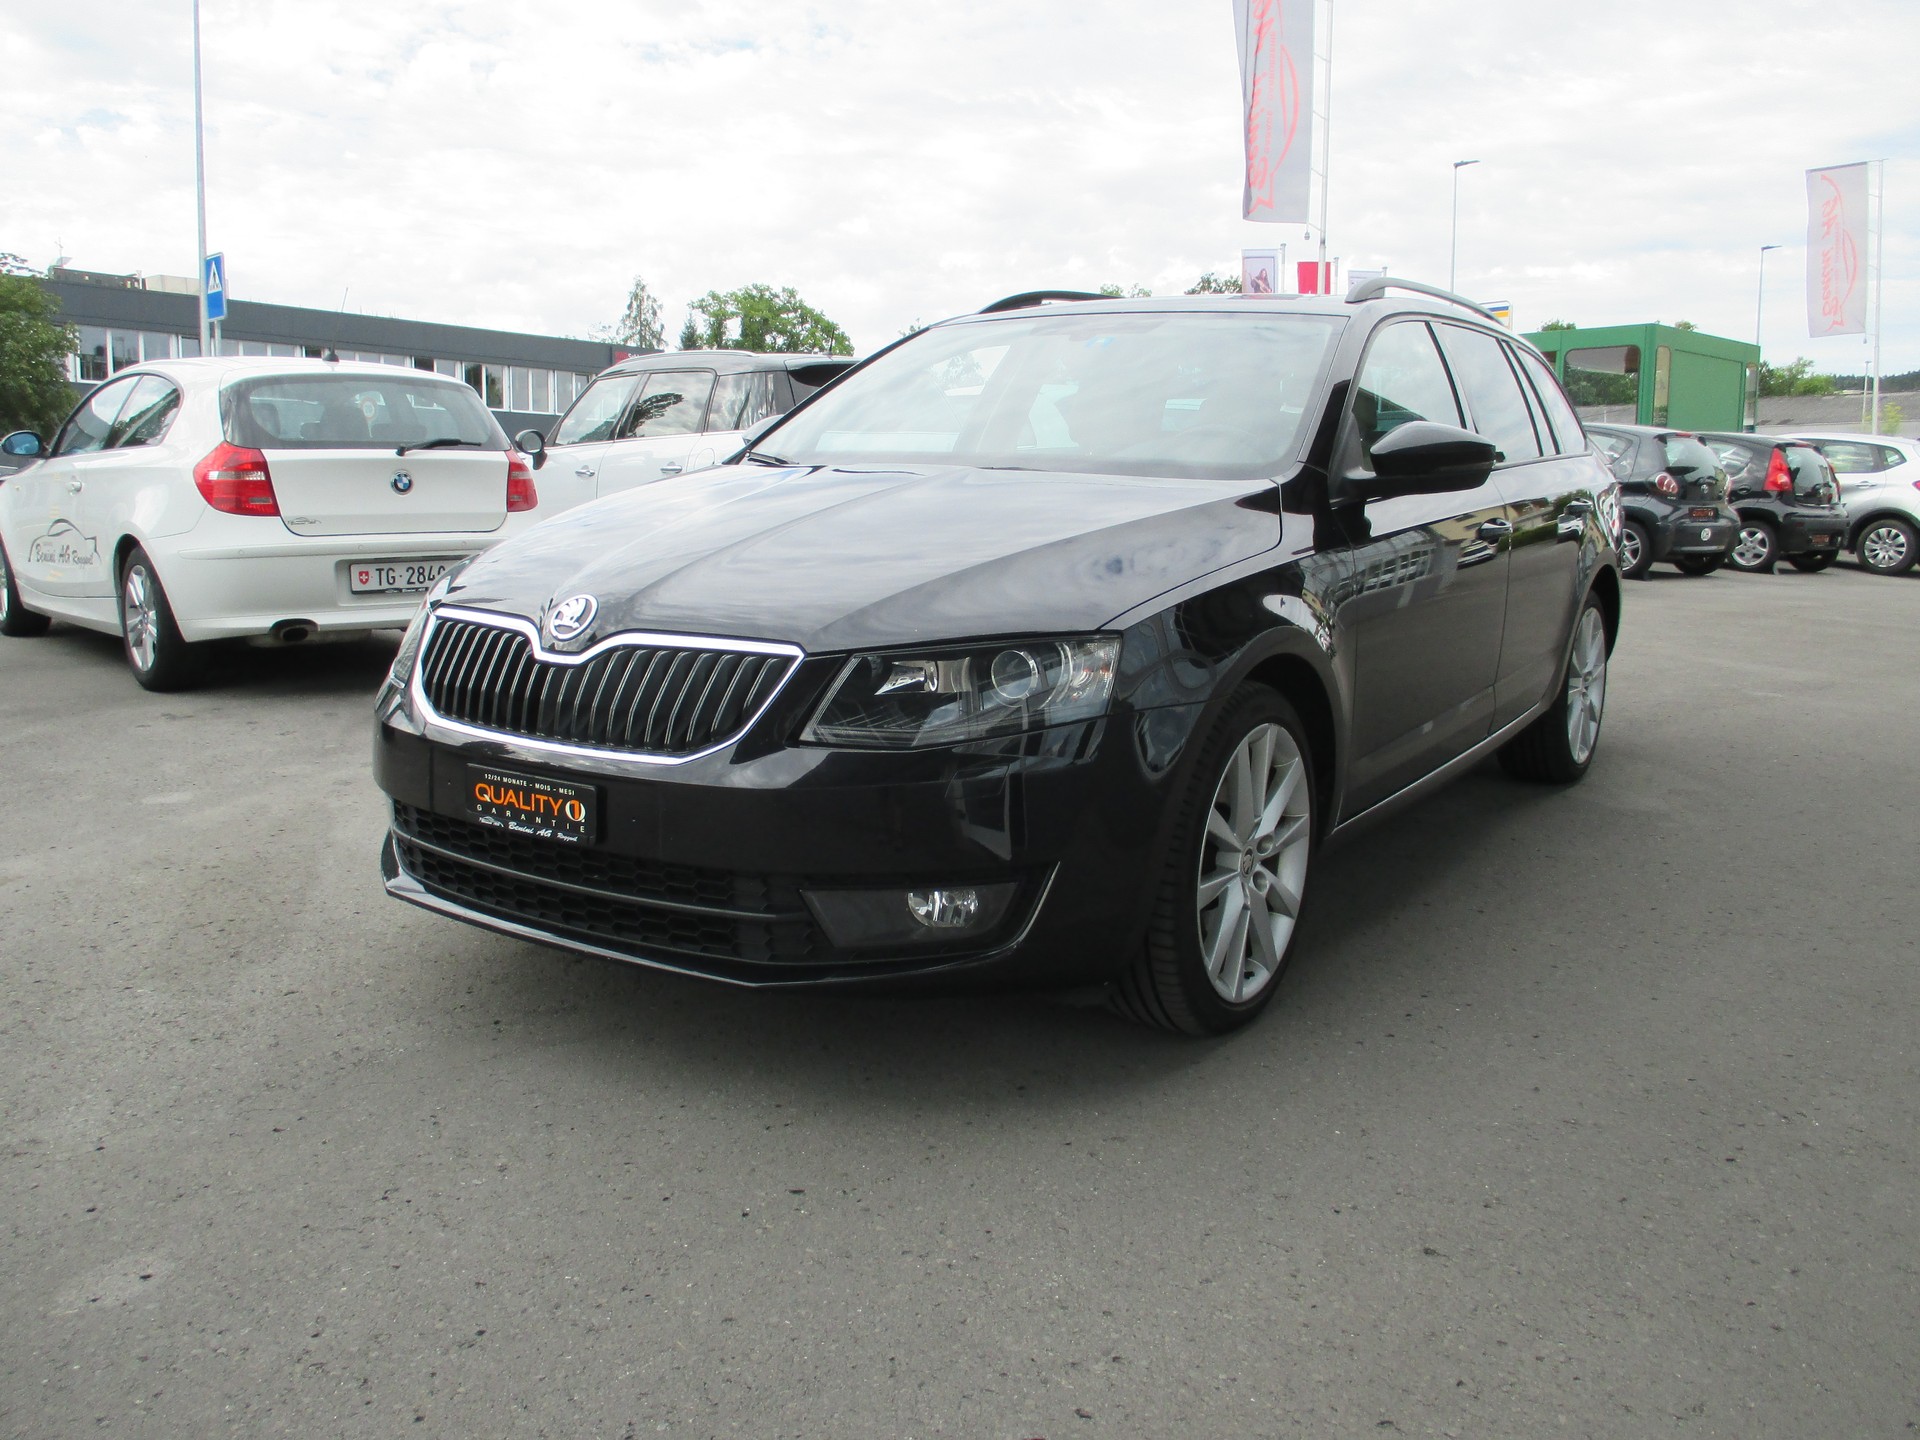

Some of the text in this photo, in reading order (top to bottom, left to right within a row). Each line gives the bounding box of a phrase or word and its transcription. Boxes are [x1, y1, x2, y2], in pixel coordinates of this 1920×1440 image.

[375, 567, 396, 586] TG
[484, 773, 575, 796] 12/24 MONATE MOIS MESI
[475, 783, 563, 816] QUALITY
[476, 804, 585, 833] GARANTIE
[508, 821, 534, 834] Benini
[536, 828, 553, 838] AG
